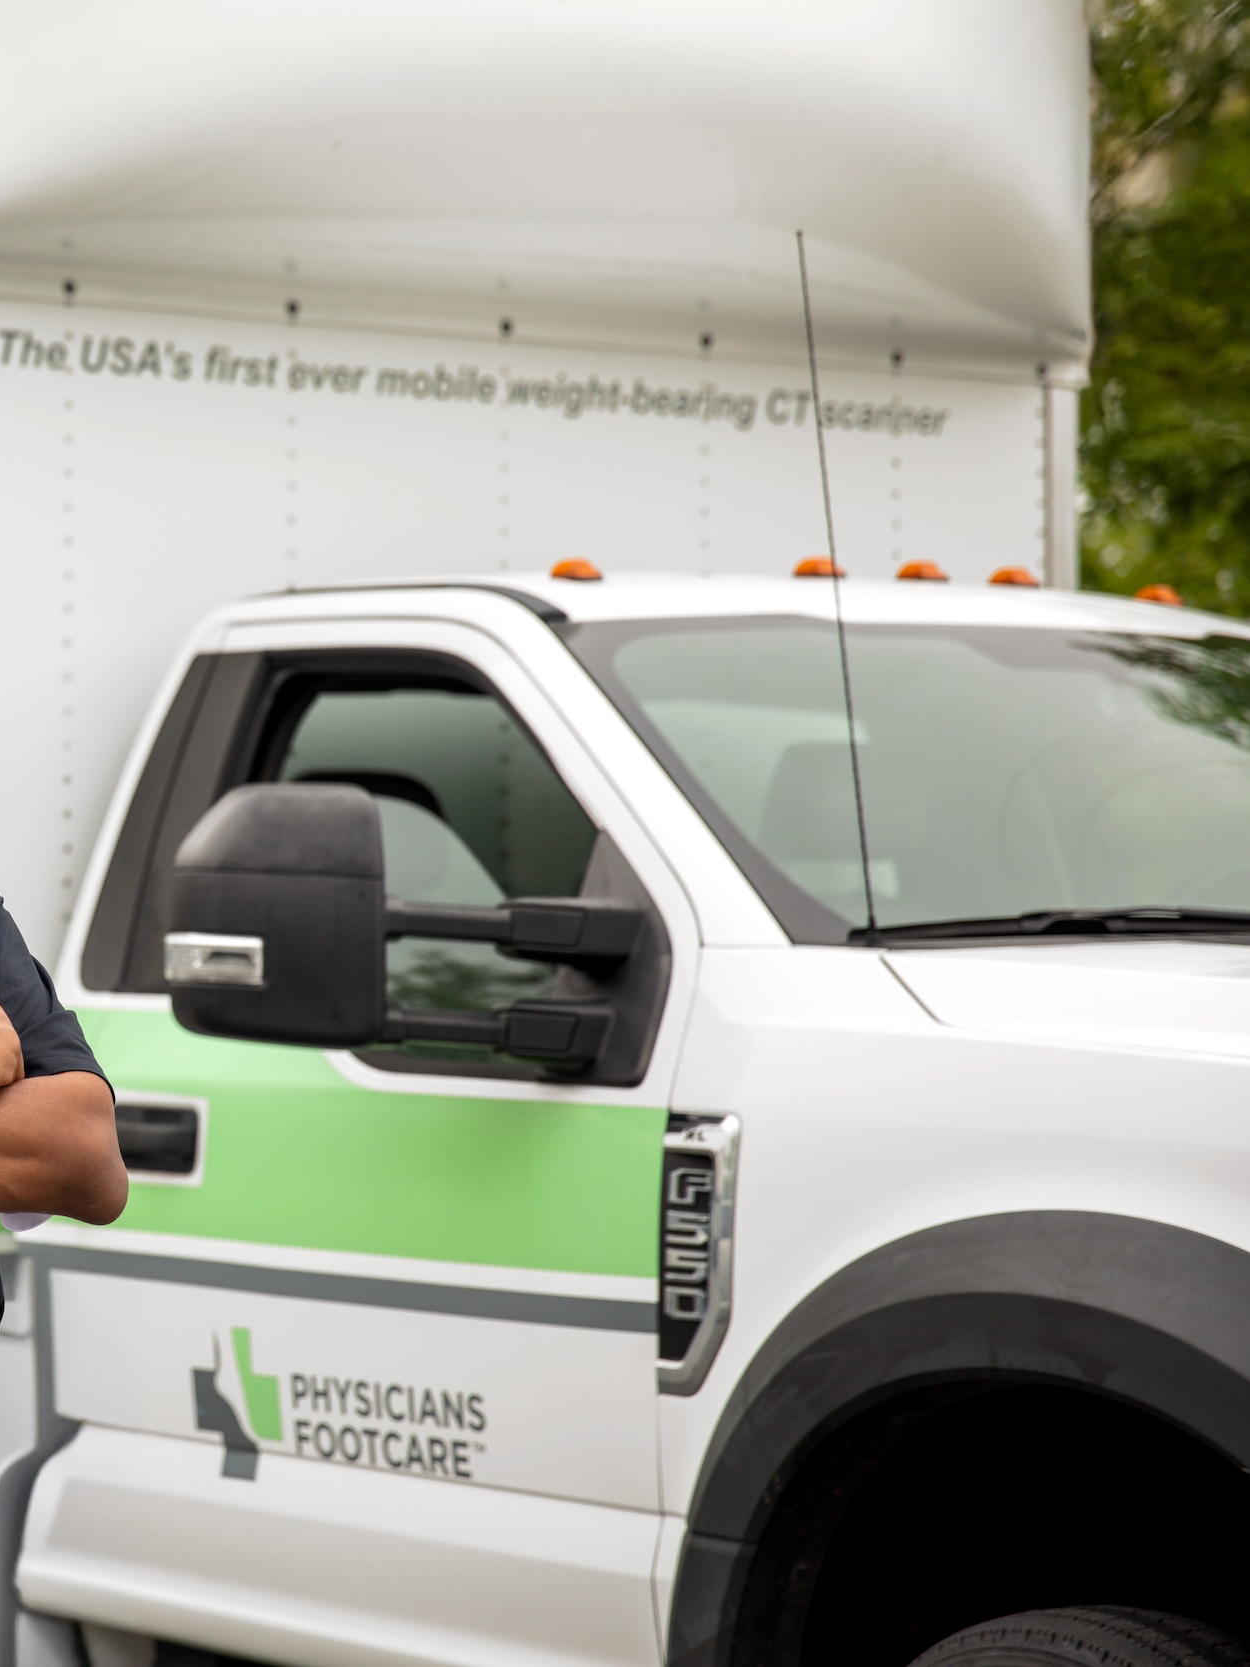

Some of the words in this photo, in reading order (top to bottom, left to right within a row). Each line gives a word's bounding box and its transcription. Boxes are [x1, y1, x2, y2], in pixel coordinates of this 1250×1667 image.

[78, 334, 194, 382] USA's
[203, 345, 279, 388] first
[287, 360, 369, 395] ever
[374, 362, 498, 402] mobile
[505, 371, 758, 431] weight-bearing
[765, 387, 815, 426] CT
[820, 400, 949, 437] scanner
[664, 1167, 714, 1321] F550
[291, 1372, 487, 1433] PHYSICIANS
[294, 1419, 474, 1479] FOOTCARE
